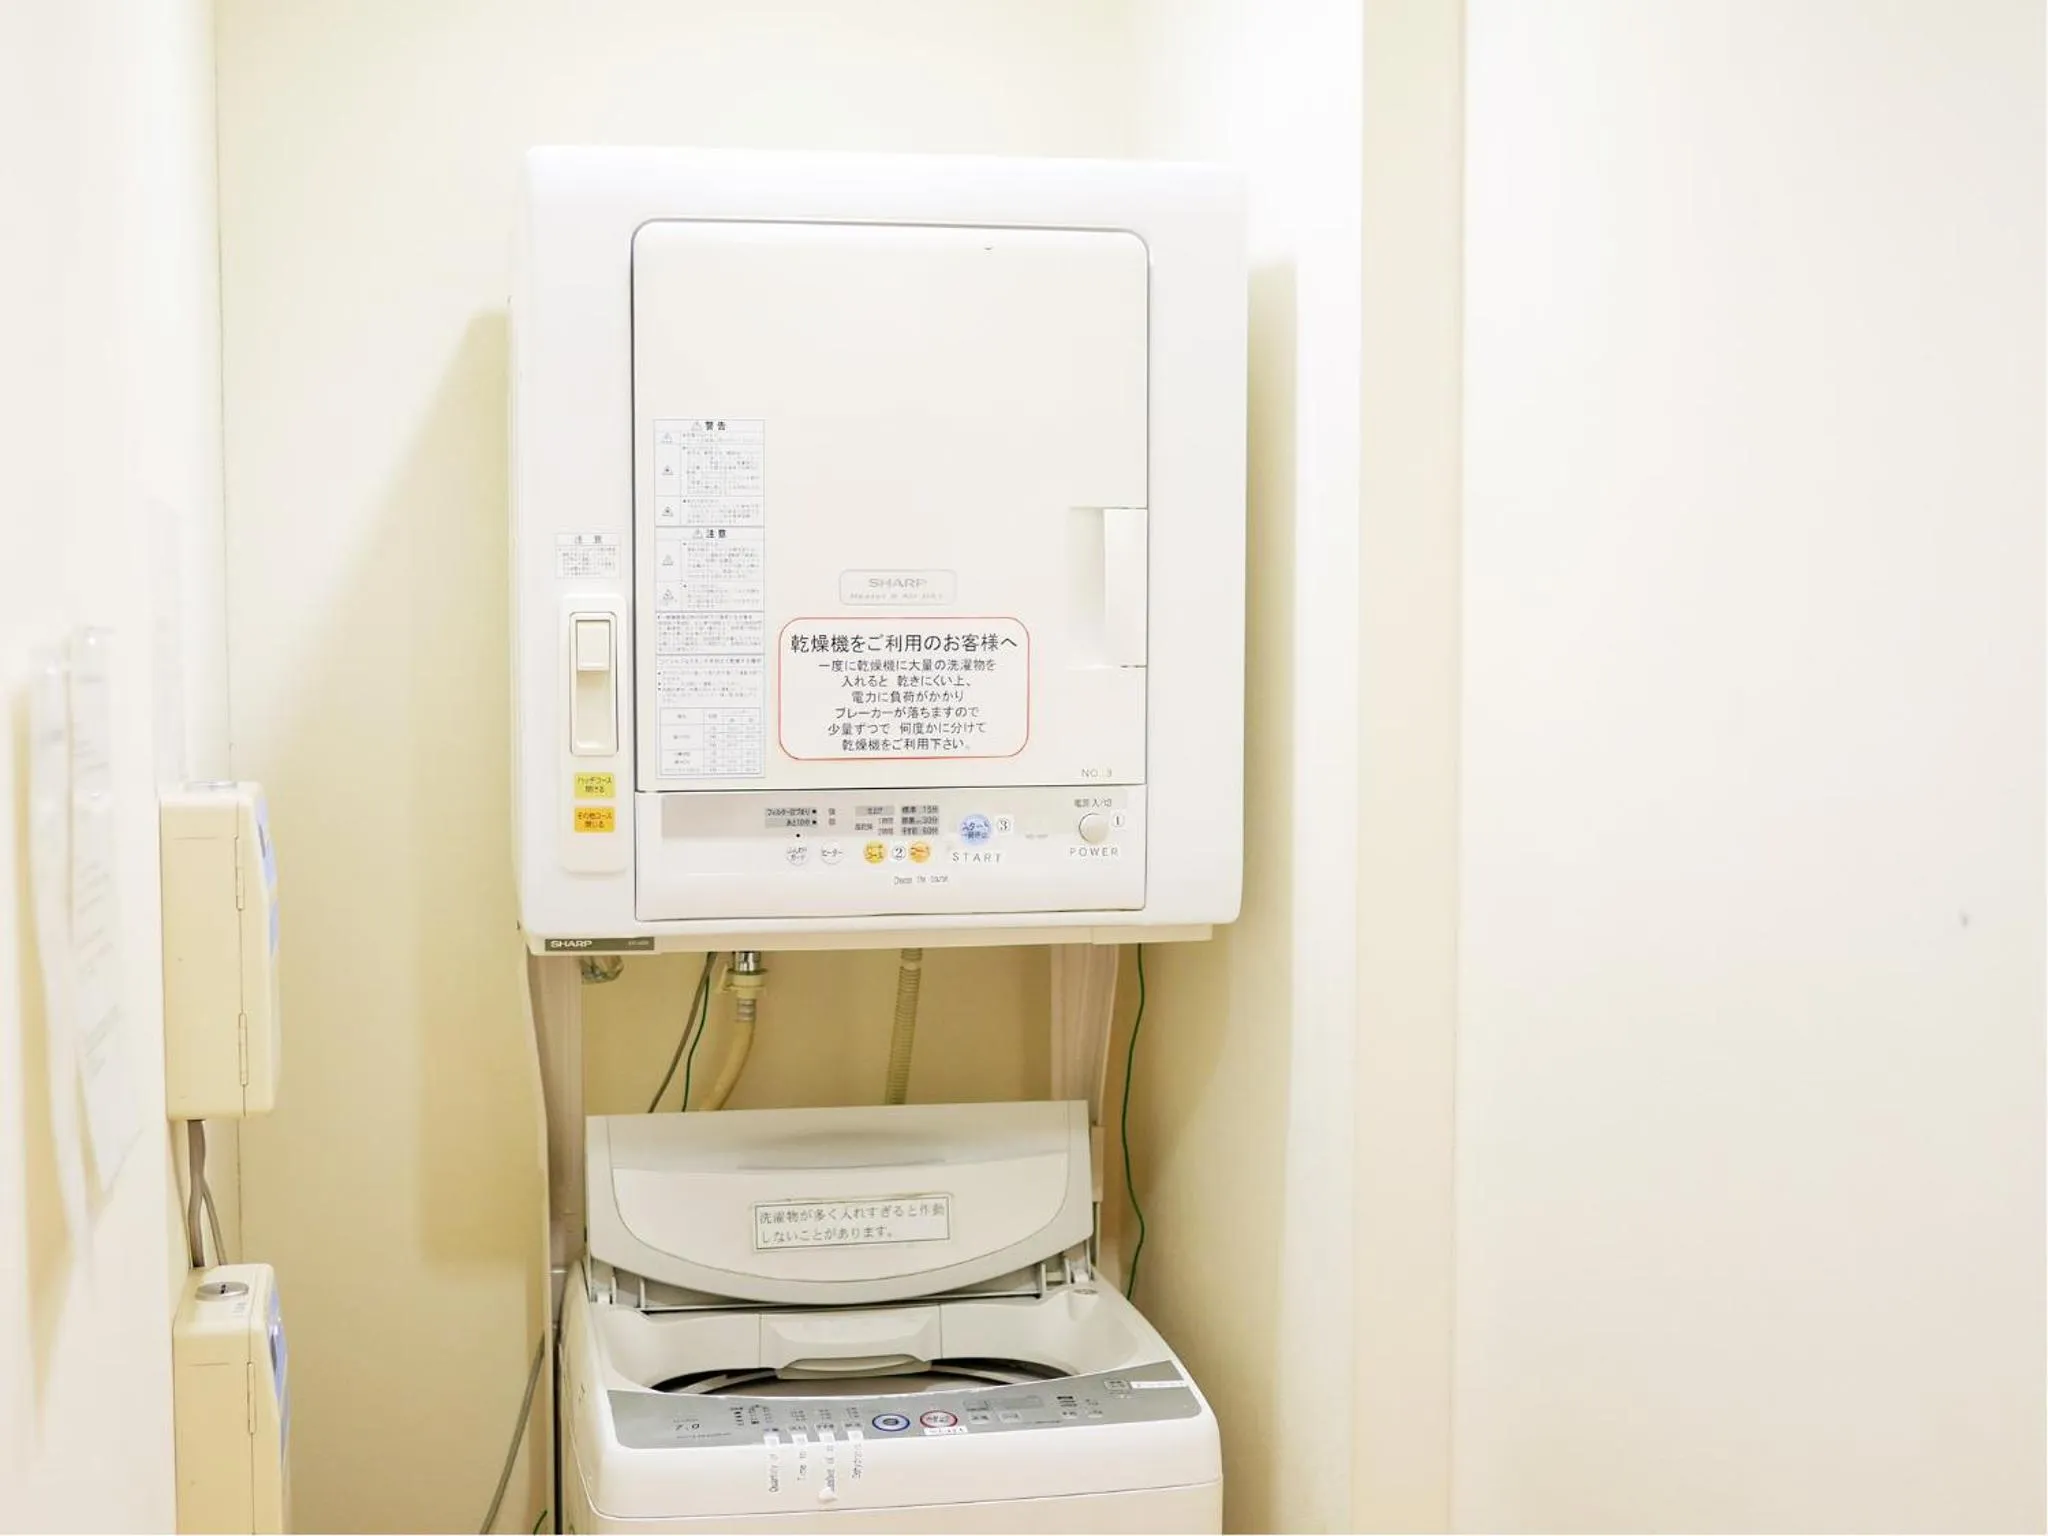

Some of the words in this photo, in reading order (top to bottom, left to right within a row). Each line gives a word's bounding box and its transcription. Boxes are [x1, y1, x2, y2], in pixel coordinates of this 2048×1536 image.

[868, 578, 928, 589] SHARP
[791, 633, 1018, 654] 乾燥機をご利用のお客様へ
[818, 658, 997, 673] 一度に乾燥機に大量の洗濯物を
[841, 675, 888, 688] 入れると
[851, 690, 964, 704] 電力に負荷がかかり
[835, 705, 981, 720] ブレーカーが落ちますので
[952, 852, 1002, 864] START
[1069, 847, 1119, 858] POWER
[550, 939, 593, 949] SHARP
[759, 1202, 945, 1225] 洗濯物が多く入れすぎると作動
[762, 1225, 893, 1244] しないことがあります。
